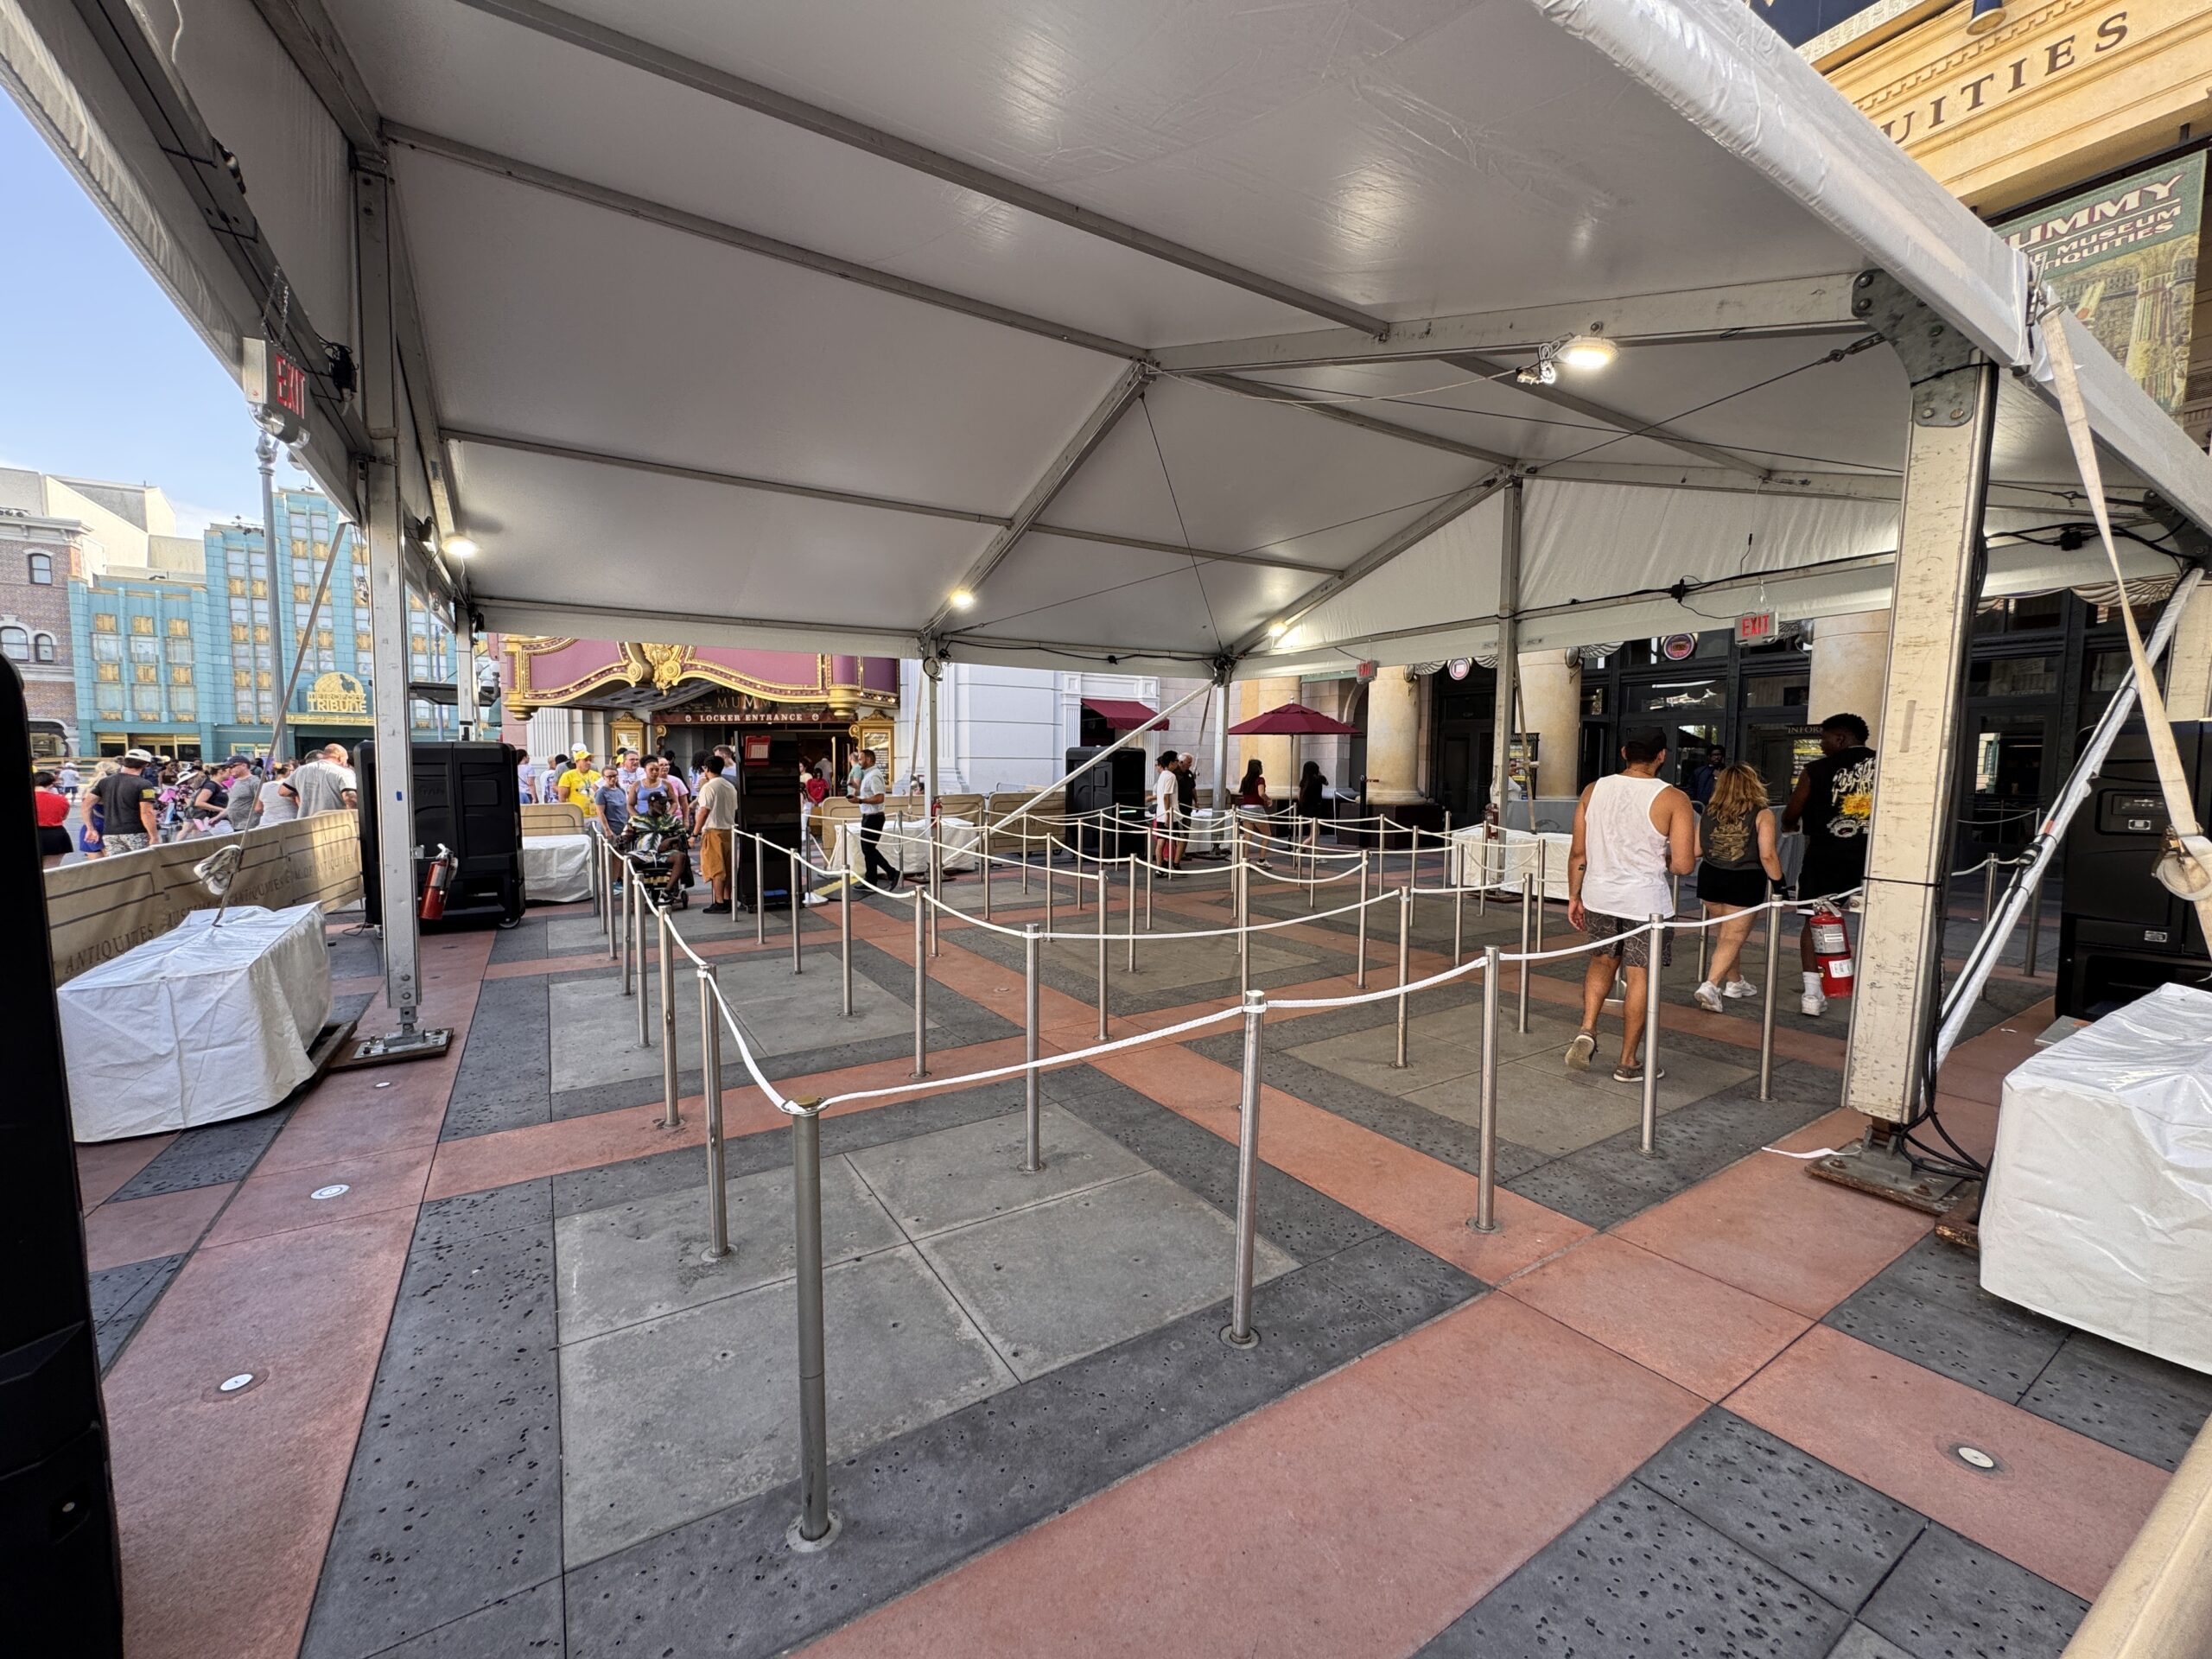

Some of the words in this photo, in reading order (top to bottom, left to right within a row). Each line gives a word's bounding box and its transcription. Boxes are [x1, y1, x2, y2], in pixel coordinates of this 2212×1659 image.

[2005, 175, 2183, 248] UMMY
[2056, 205, 2182, 256] MUSEUM
[276, 353, 306, 420] EXIT
[1741, 614, 1770, 638] EXIT
[308, 701, 367, 714] TRIBUNE
[700, 714, 741, 722] LOCKER
[745, 713, 803, 722] ENTRANCE
